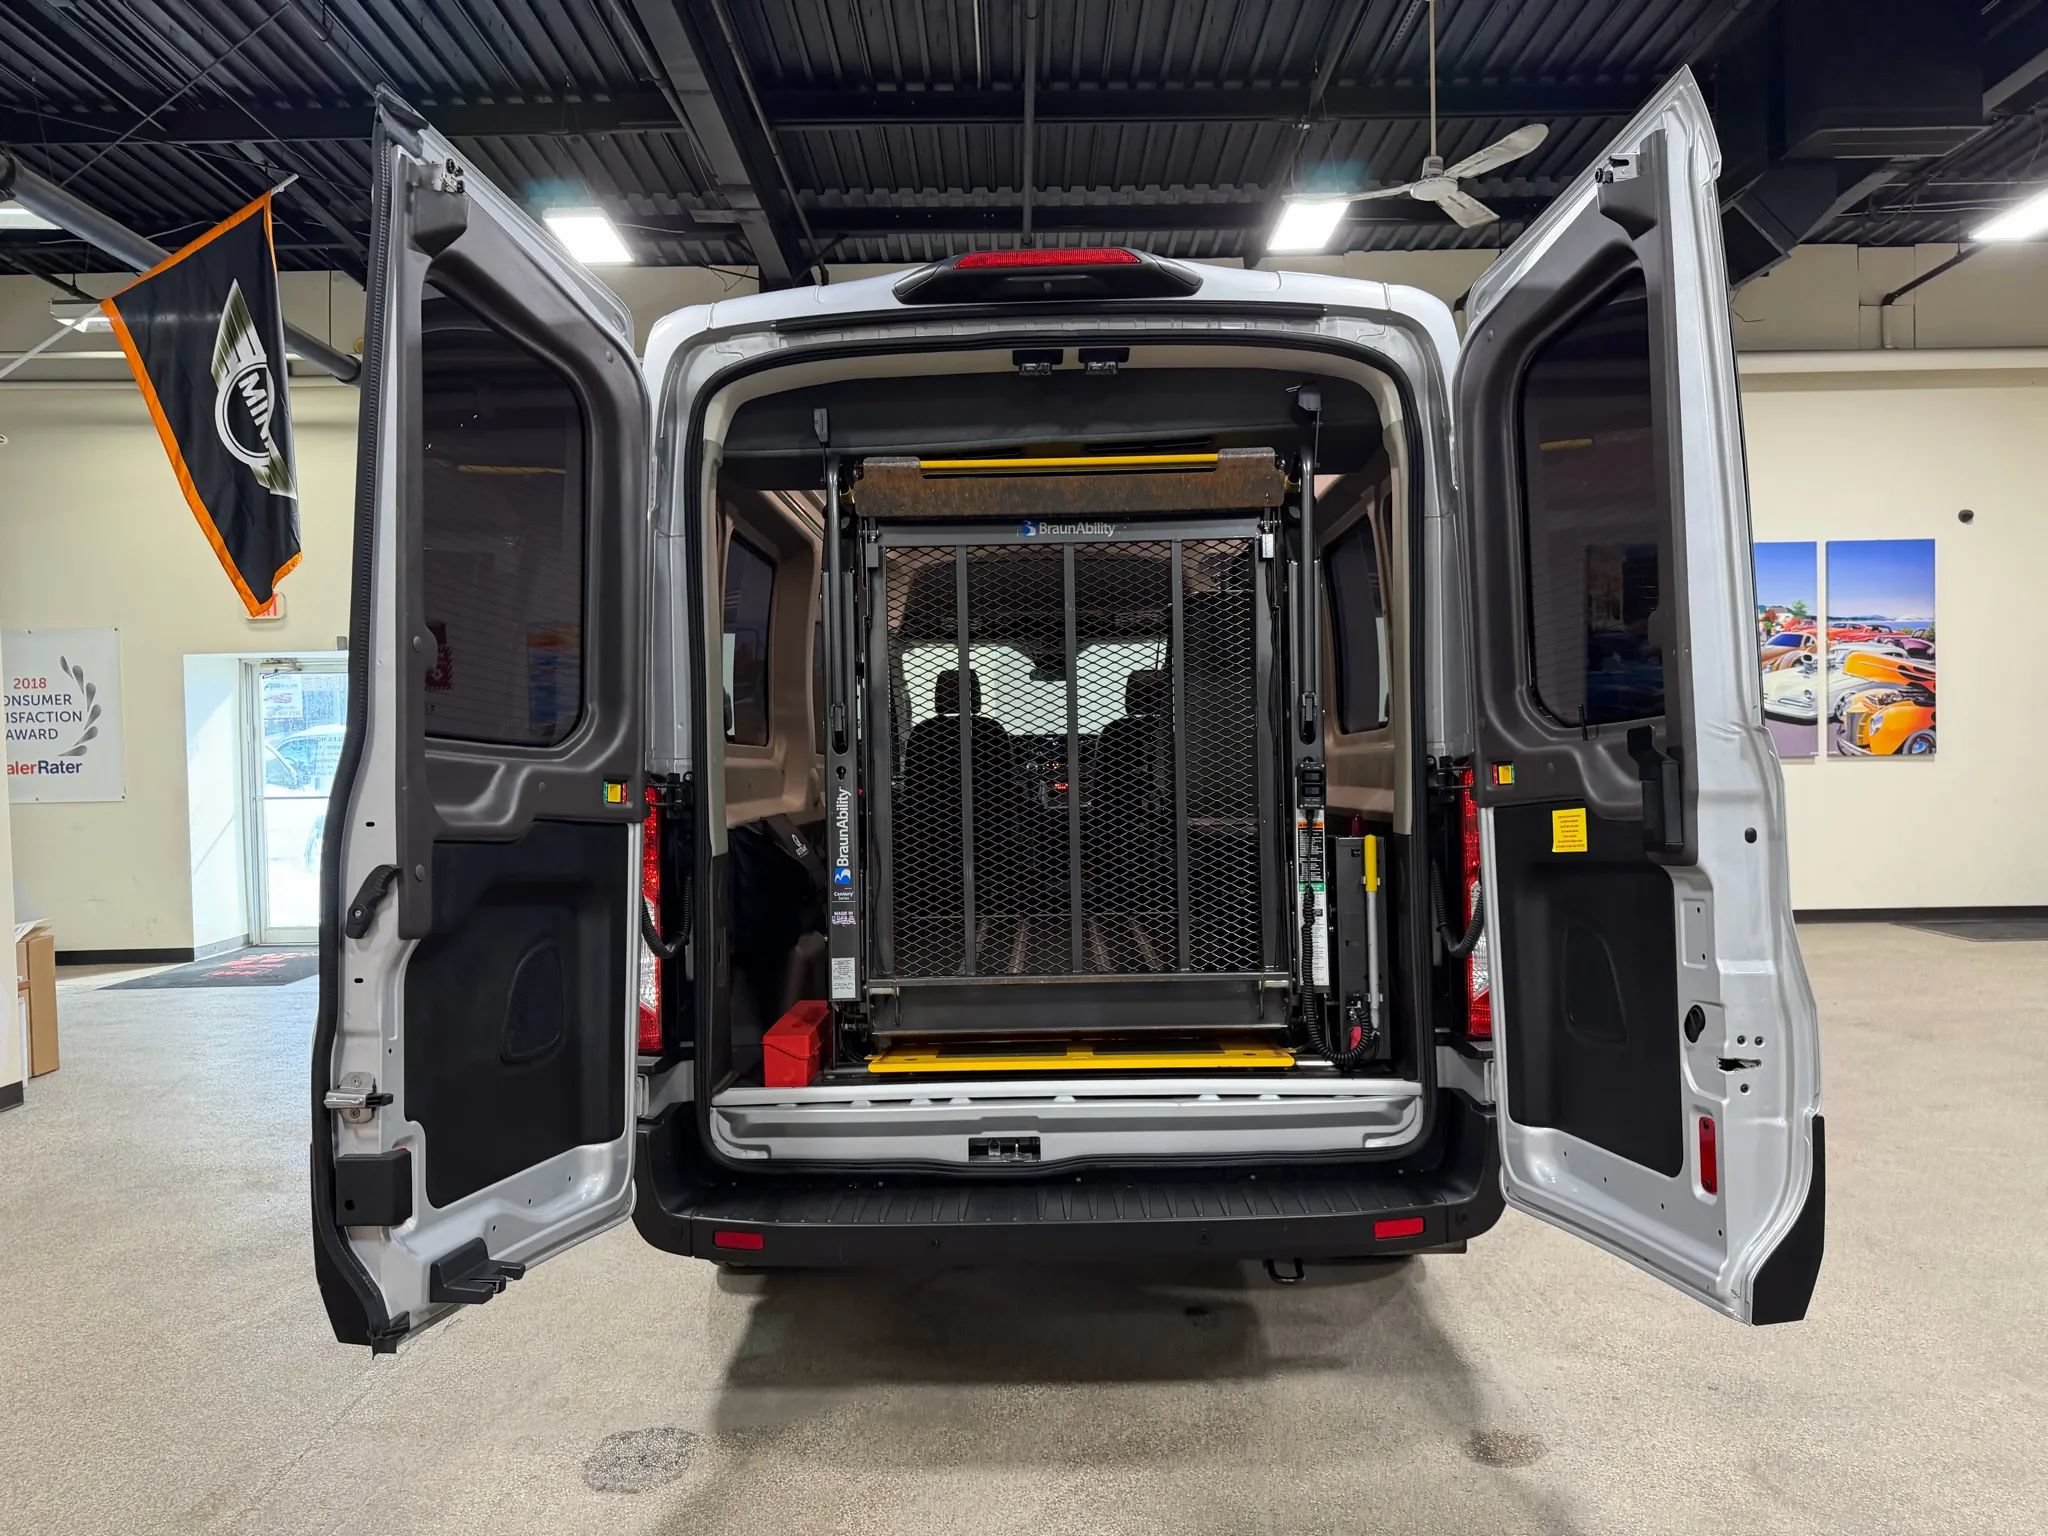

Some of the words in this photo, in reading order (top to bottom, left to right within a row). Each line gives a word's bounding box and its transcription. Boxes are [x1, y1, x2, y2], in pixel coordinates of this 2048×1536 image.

[238, 372, 270, 449] MIN
[1039, 522, 1115, 537] BraunAbility
[13, 678, 47, 689] 2018
[4, 694, 72, 706] ONSUMER
[6, 711, 82, 723] ISFACTION
[6, 729, 58, 740] AWARD
[7, 760, 82, 775] alerRater
[836, 787, 851, 867] BraunAbility
